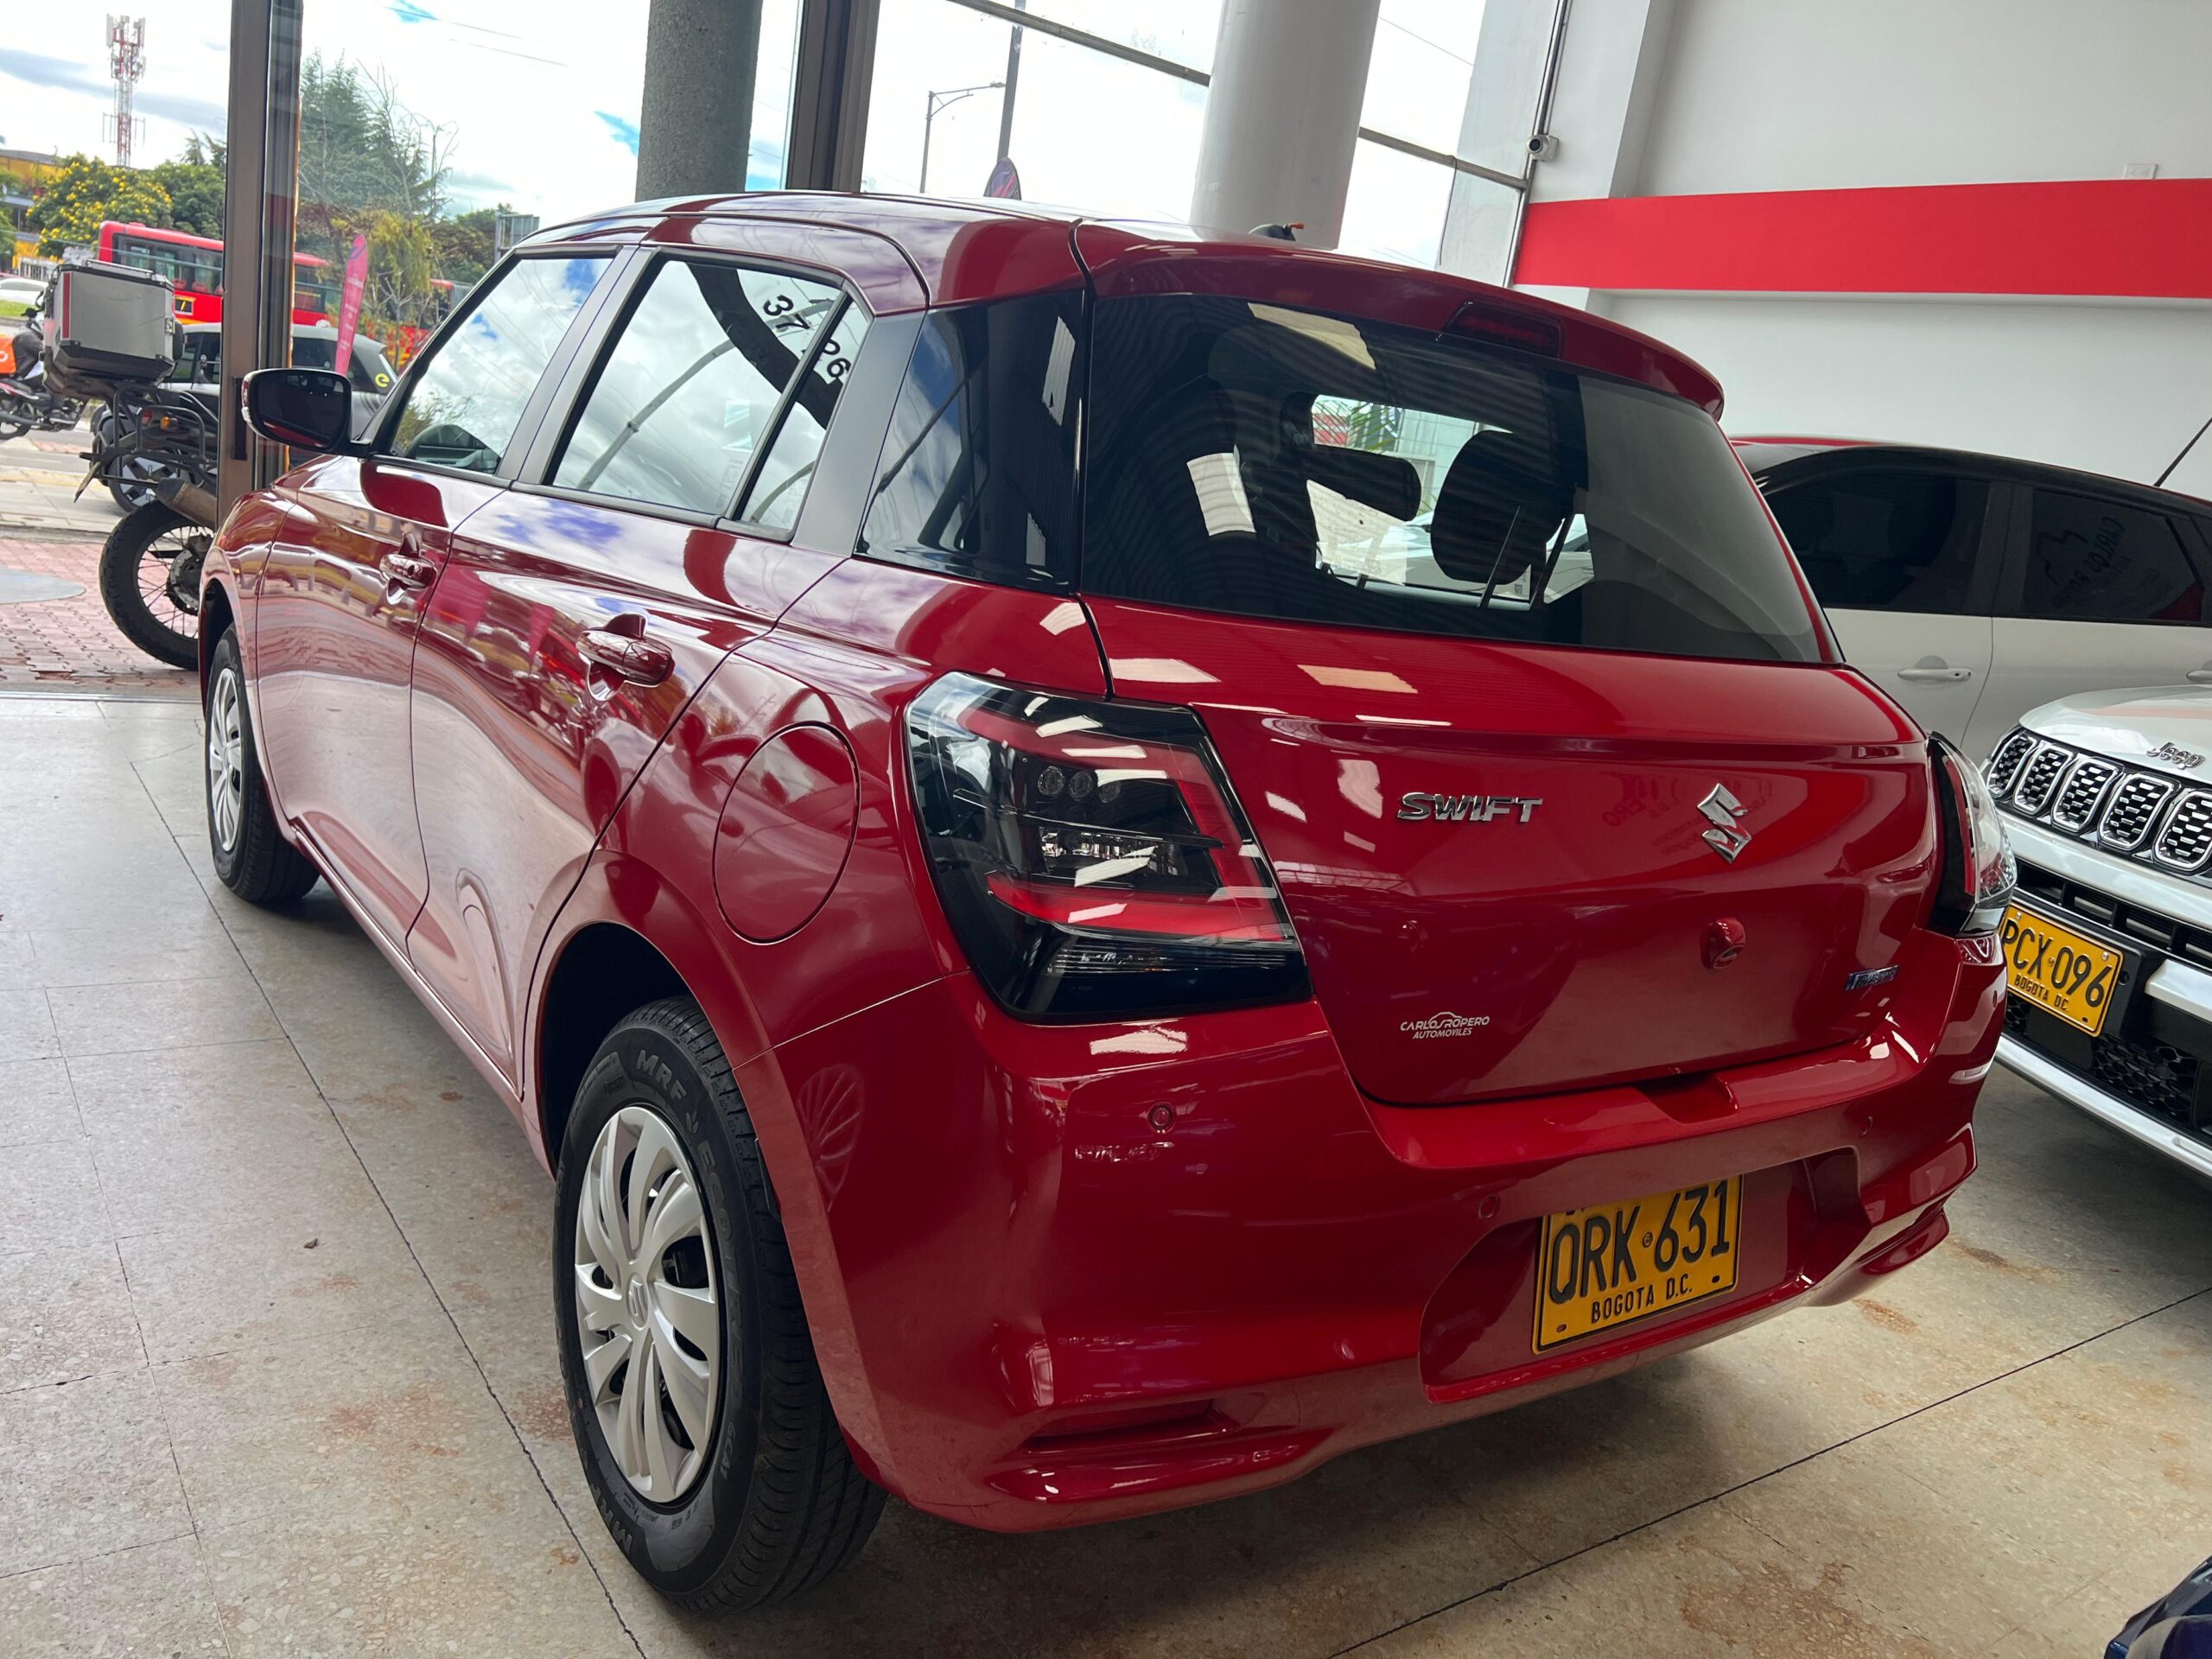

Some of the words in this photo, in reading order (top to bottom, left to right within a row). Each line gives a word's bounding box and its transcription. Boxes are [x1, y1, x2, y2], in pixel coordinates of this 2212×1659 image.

[763, 295, 810, 329] 37
[2146, 742, 2205, 770] Jeep
[1397, 792, 1542, 822] SWIFT
[2003, 918, 2054, 980] PCX
[2051, 946, 2113, 1007] 096
[2014, 974, 2049, 1002] BOGOTA
[1413, 1027, 1473, 1039] AUTOMOVILES
[1444, 1016, 1491, 1029] ROPERO
[636, 1049, 687, 1101] MRF
[1655, 1179, 1730, 1272] 631
[1592, 1284, 1654, 1324] BOGOTA
[1666, 1273, 1693, 1300] D.C.
